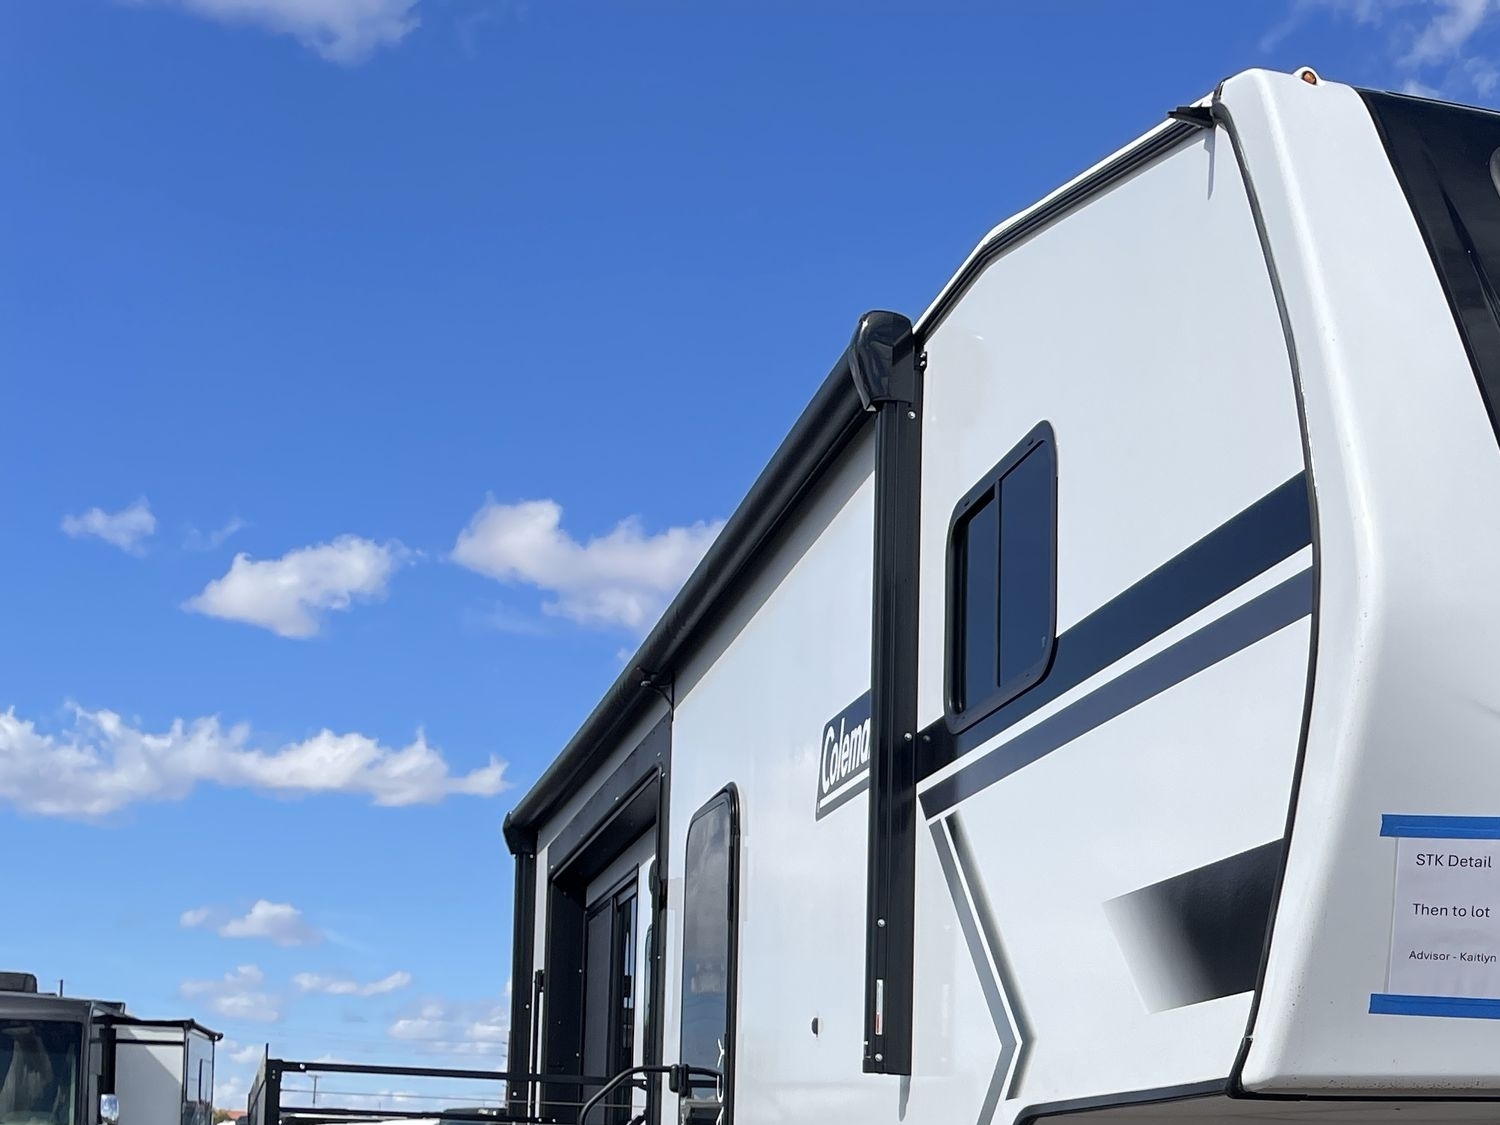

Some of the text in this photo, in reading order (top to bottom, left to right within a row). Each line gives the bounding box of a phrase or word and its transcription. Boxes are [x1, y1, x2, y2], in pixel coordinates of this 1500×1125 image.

[821, 717, 871, 794] Colema
[1415, 853, 1492, 868] STK Detail
[1412, 903, 1491, 918] Then to lot
[1408, 950, 1450, 961] Advisor
[1459, 952, 1497, 964] Kaitlyn
